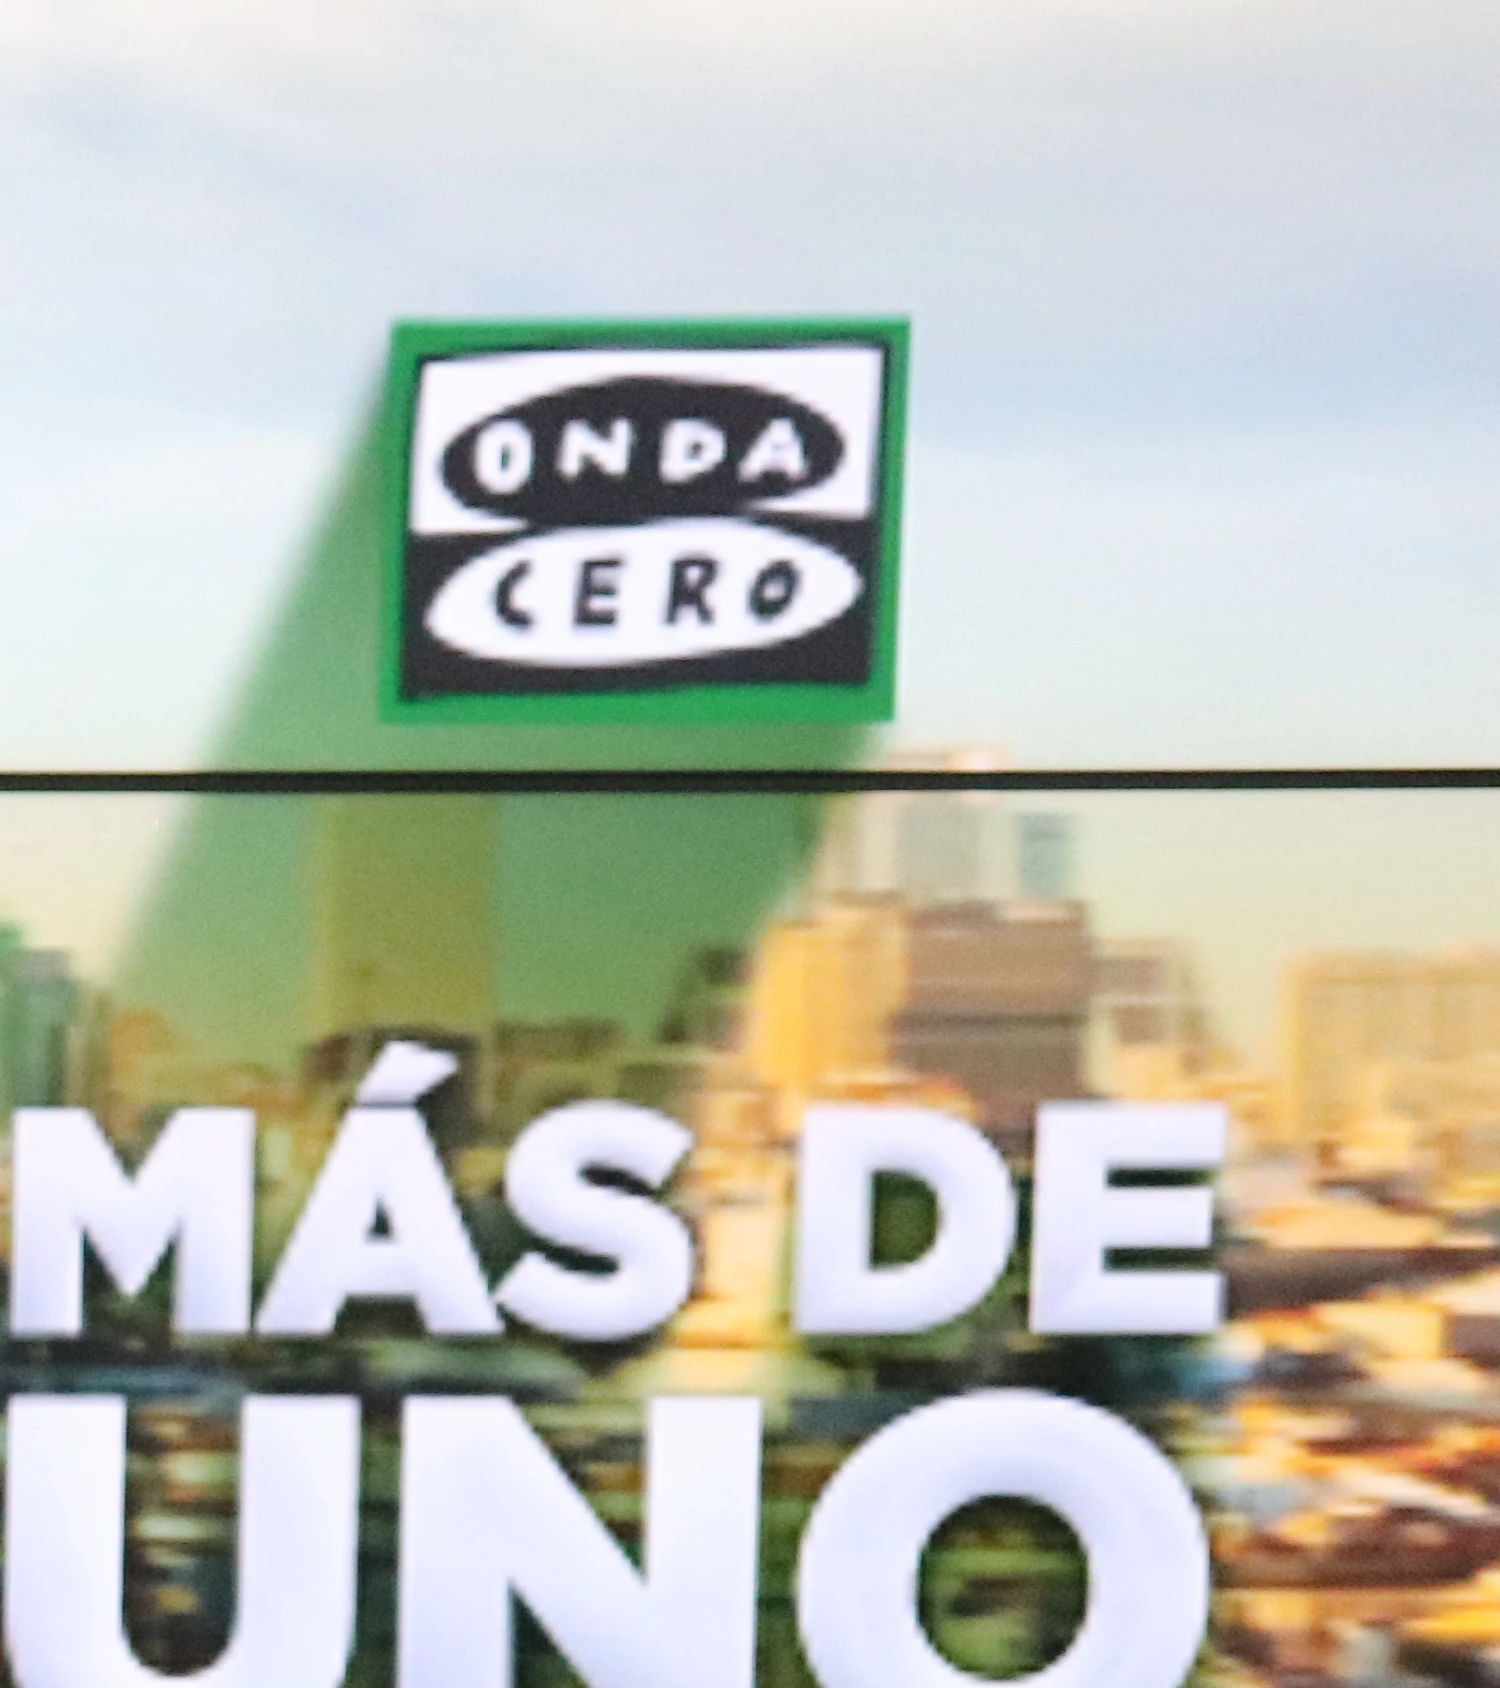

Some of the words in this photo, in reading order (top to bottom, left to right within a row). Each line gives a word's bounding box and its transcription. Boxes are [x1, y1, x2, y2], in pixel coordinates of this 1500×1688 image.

[472, 417, 809, 494] ONDA
[495, 553, 801, 630] CERO
[10, 1040, 697, 1342] MÁS
[794, 1102, 1228, 1334] DE
